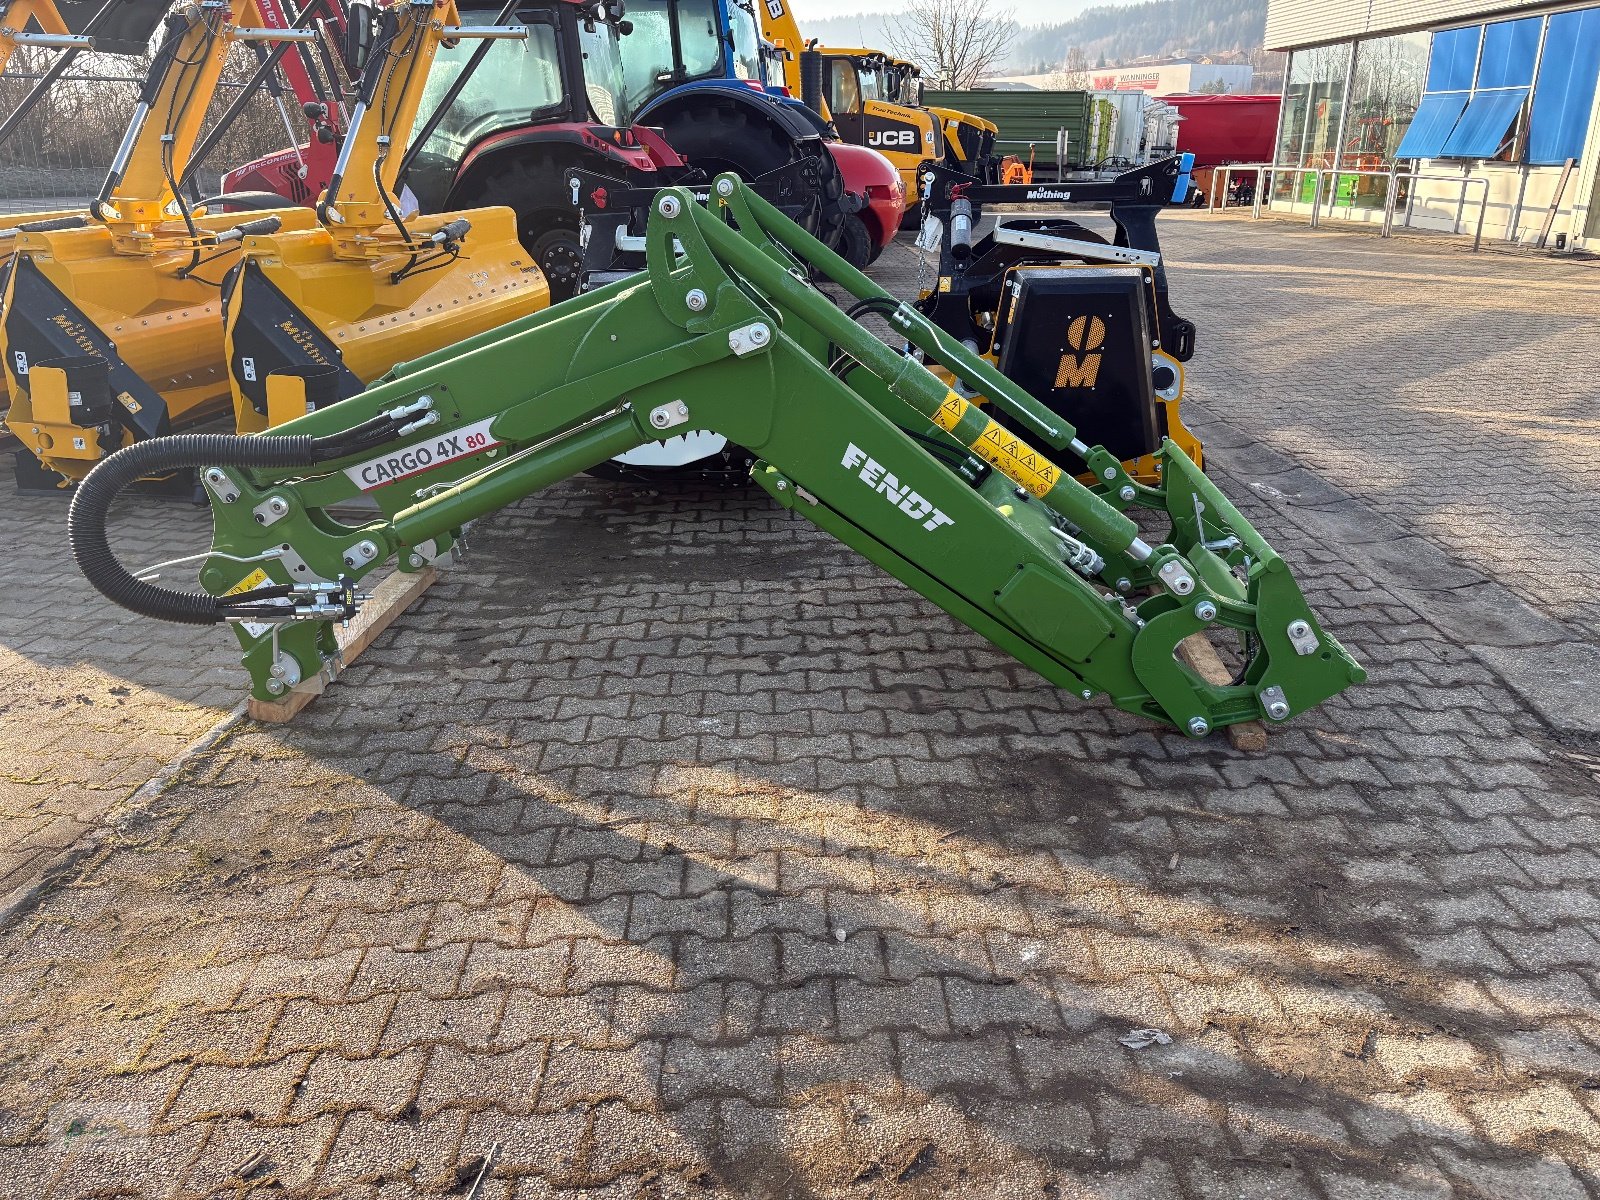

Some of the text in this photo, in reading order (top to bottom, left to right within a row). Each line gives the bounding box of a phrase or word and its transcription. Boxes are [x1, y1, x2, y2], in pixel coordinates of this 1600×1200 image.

[1120, 73, 1160, 81] WANNINGER
[868, 131, 915, 146] JCB
[1027, 186, 1071, 200] Müthing
[361, 432, 486, 485] CARGO 4X 80
[840, 441, 956, 532] FENDT
